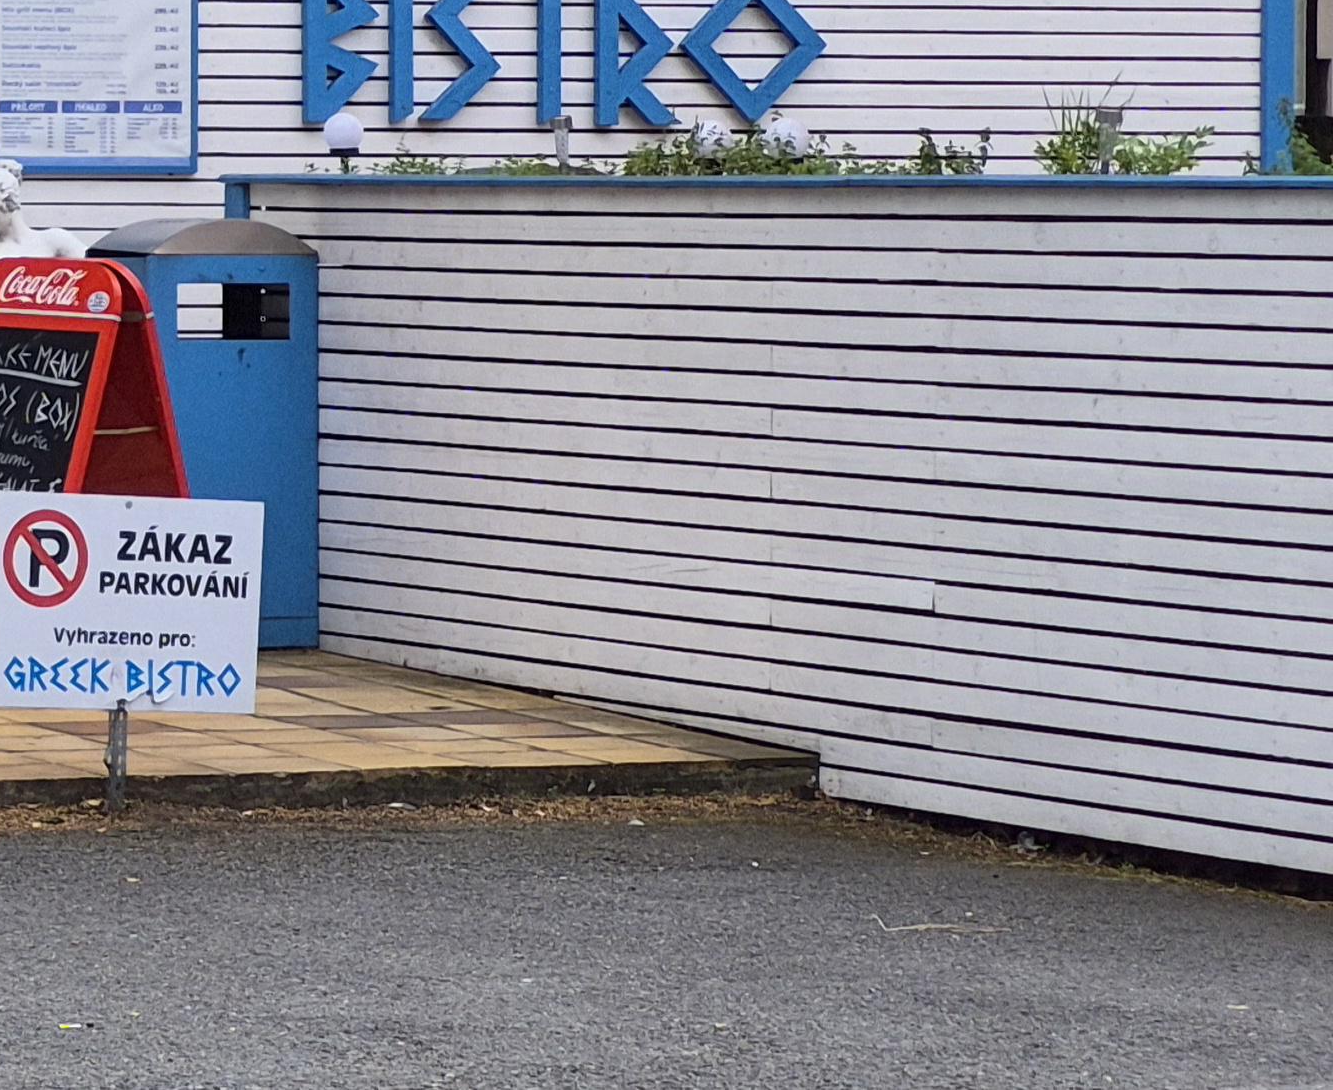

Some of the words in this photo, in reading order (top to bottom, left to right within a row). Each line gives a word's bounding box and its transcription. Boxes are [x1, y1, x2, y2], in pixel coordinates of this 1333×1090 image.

[34, 344, 90, 379] MENU
[26, 390, 80, 442] (BOX)
[116, 525, 233, 565] ZÁKAZ
[99, 570, 250, 599] PARKOVÁNÍ
[53, 627, 154, 647] Vyhrazeno
[158, 632, 196, 648] pro:
[3, 655, 111, 694] GREEK
[126, 658, 242, 698] BISTRO
